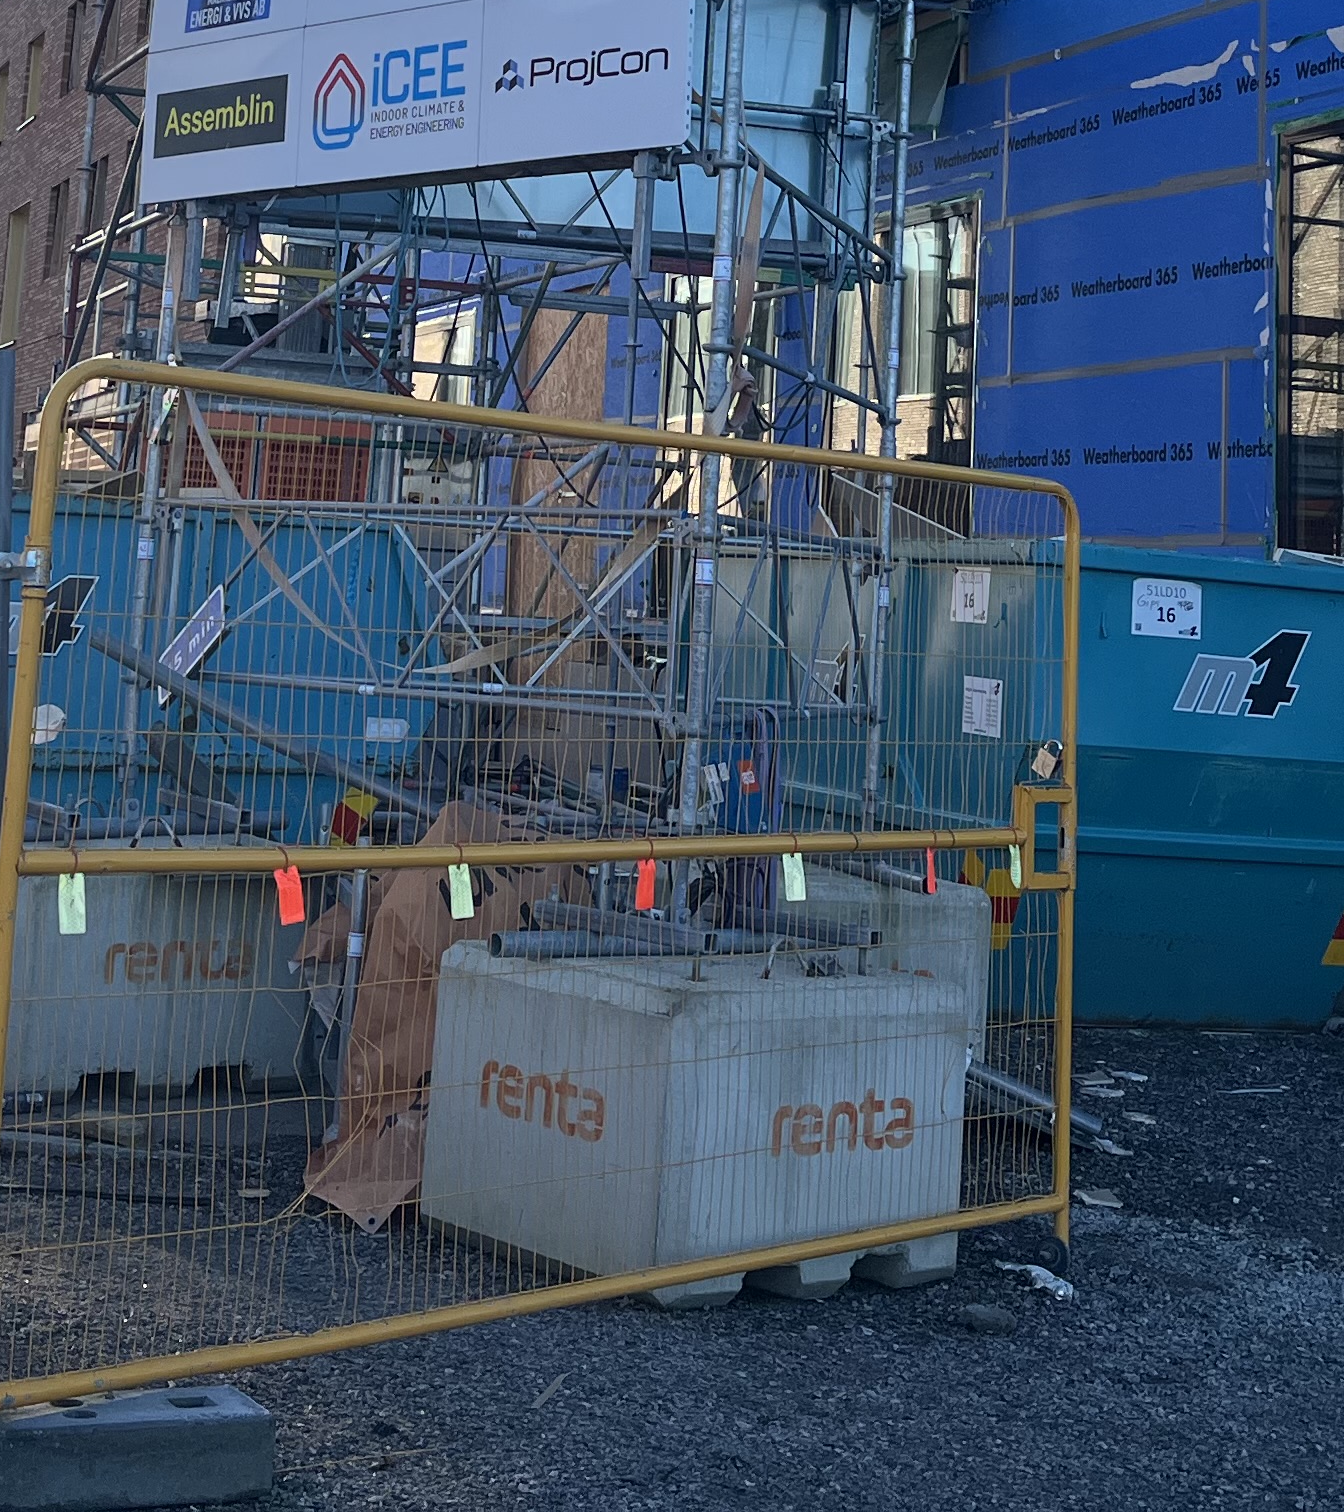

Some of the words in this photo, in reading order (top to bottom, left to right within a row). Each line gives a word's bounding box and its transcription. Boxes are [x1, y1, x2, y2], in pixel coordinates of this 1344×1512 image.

[189, 6, 222, 30] ENERGI
[224, 6, 232, 23] &
[233, 2, 252, 22] VVS
[253, 0, 266, 20] AB
[372, 39, 468, 107] iCEE
[530, 46, 669, 87] ProjCon
[163, 93, 275, 140] Assemblin
[370, 108, 409, 124] INDOOR
[411, 103, 455, 120] CLIMATE
[457, 101, 465, 113] &
[1080, 115, 1100, 133] 365
[1112, 89, 1196, 126] Weatherboard
[1199, 83, 1222, 105] 365
[369, 123, 404, 142] ENERGY
[405, 115, 465, 137] ENGINEERING
[934, 143, 999, 171] Weatherboard
[1040, 285, 1060, 303] 365
[1071, 275, 1152, 298] Weatherboard
[1155, 266, 1178, 285] 365
[977, 448, 1048, 470] Weatherboard
[1051, 448, 1071, 467] 365
[1084, 443, 1167, 466] Weatherboard
[1171, 443, 1194, 462] 365
[1157, 607, 1176, 623] 16
[105, 932, 253, 985] renta
[479, 1059, 605, 1143] renta
[771, 1087, 914, 1158] renta
